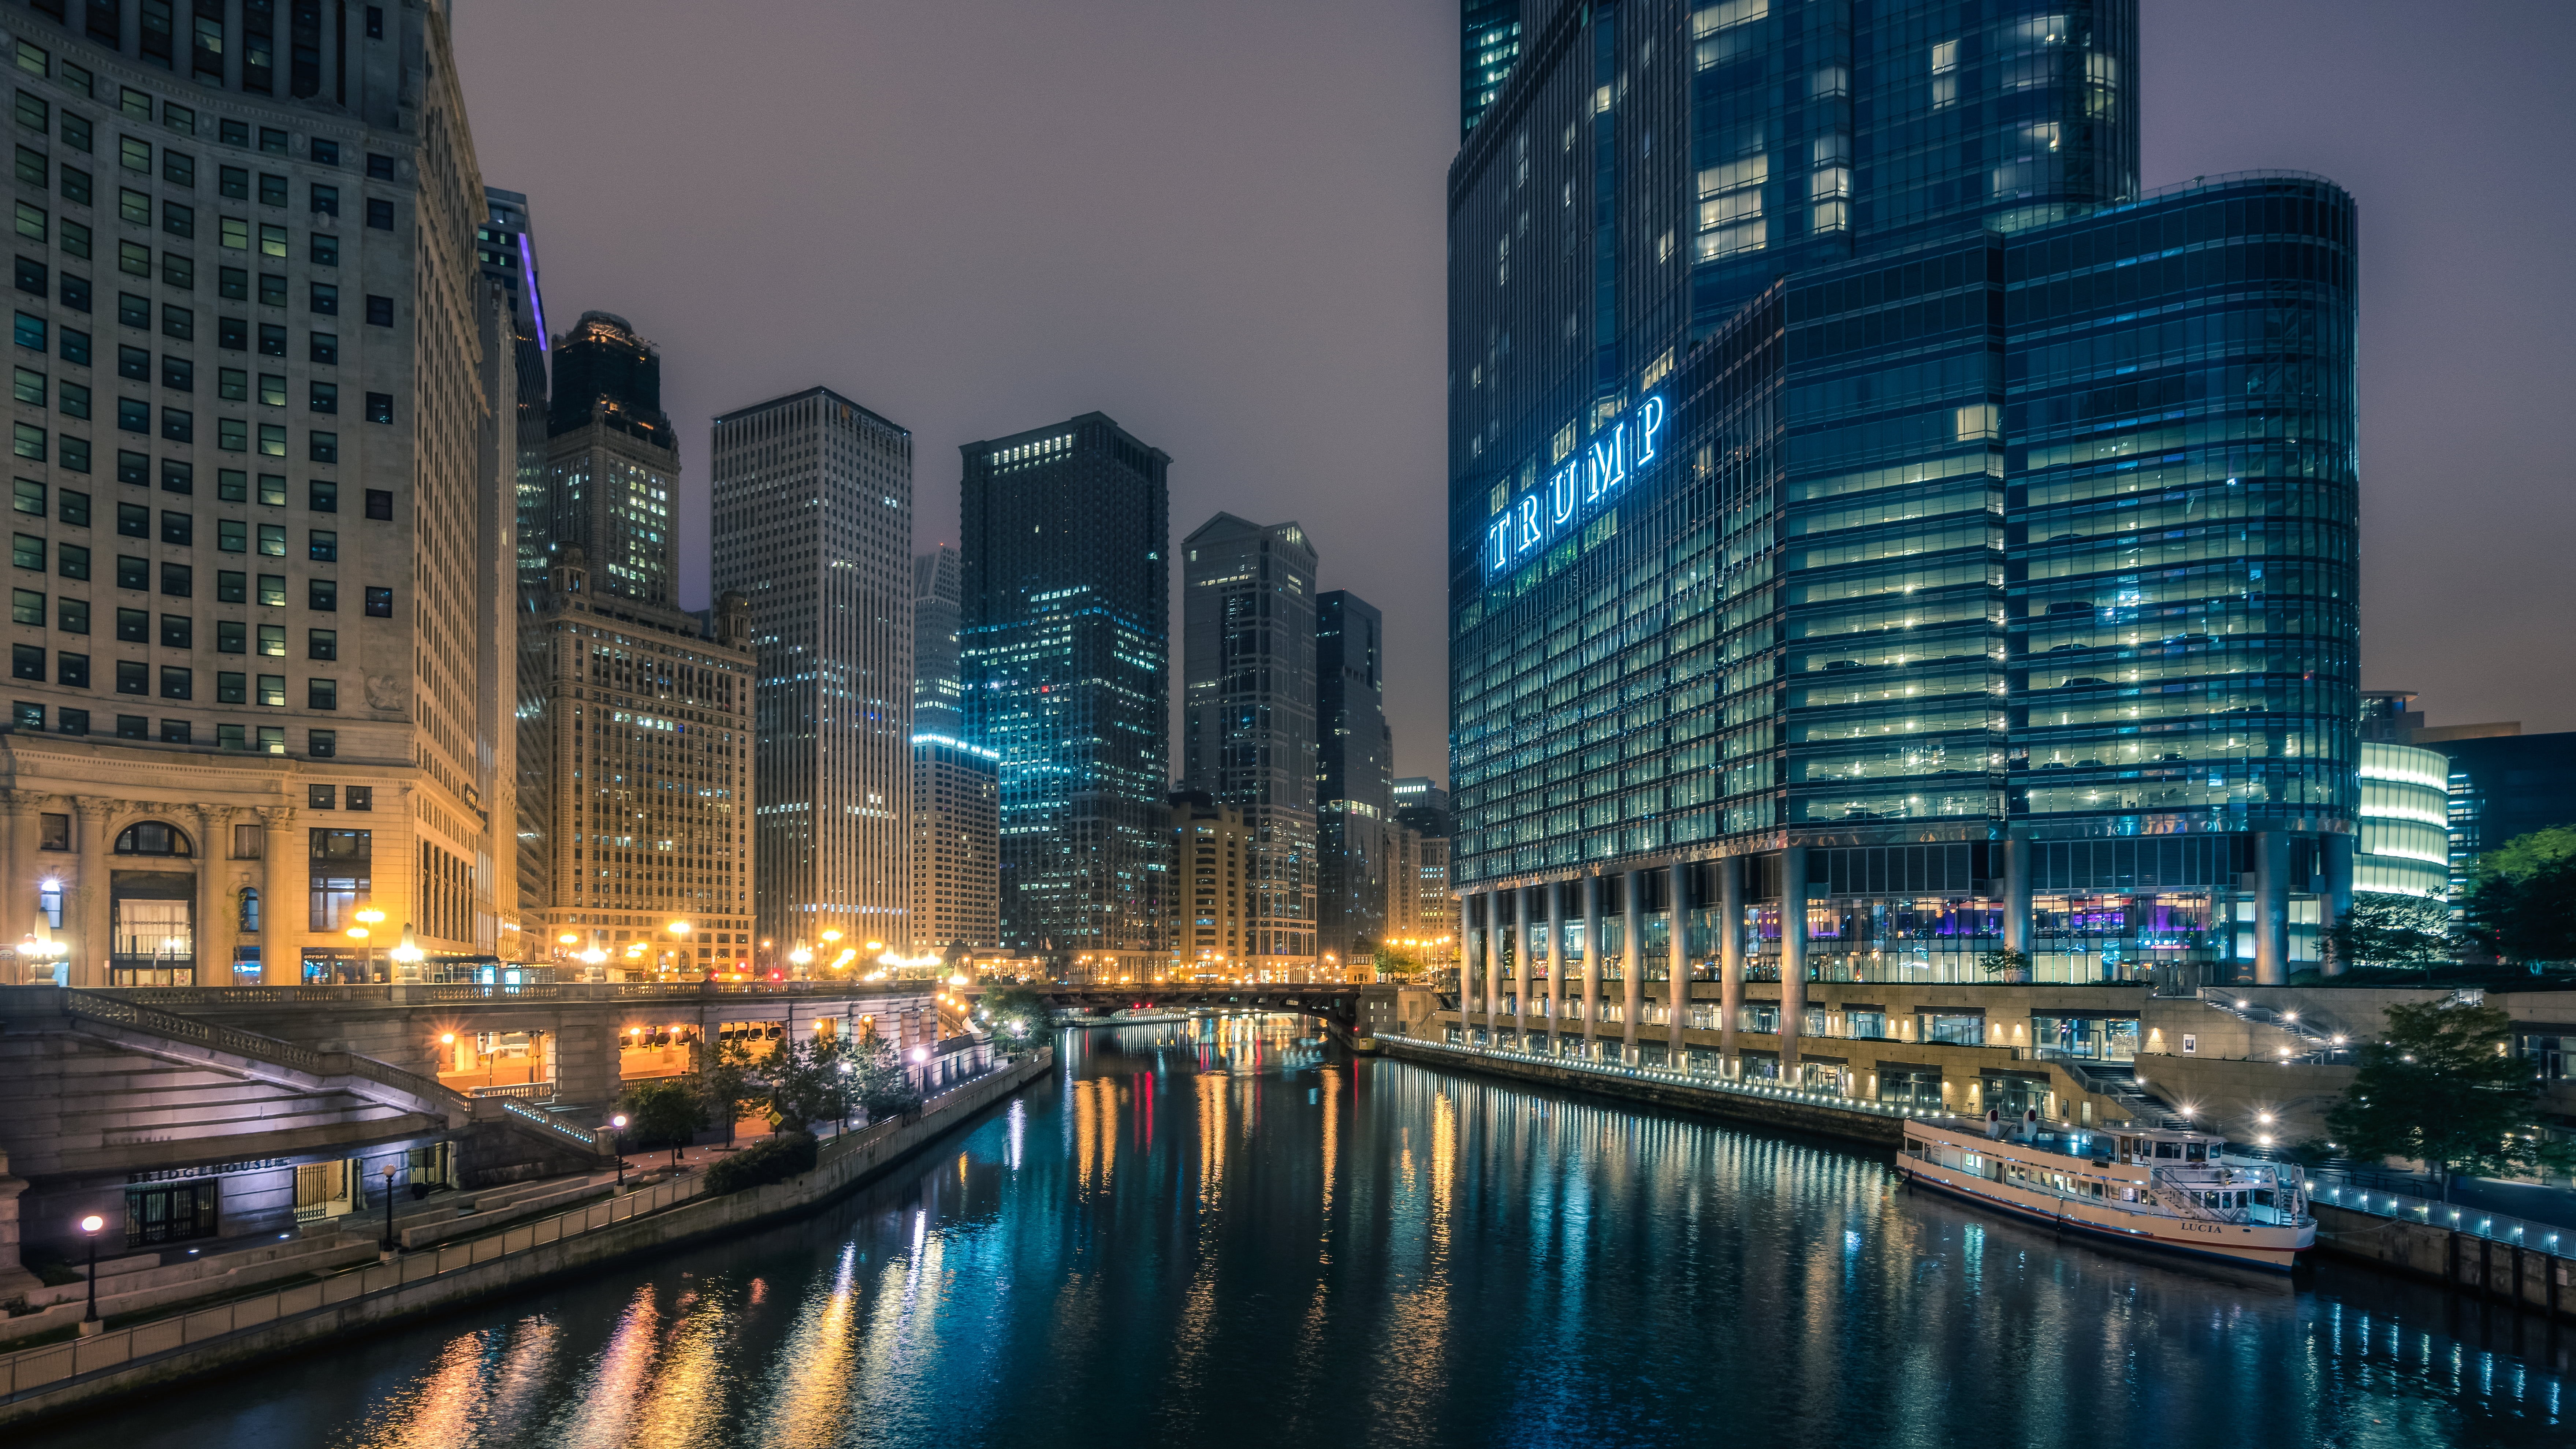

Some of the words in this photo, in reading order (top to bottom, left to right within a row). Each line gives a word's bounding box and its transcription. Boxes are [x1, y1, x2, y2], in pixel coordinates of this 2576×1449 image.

[853, 410, 900, 441] KEMPER
[1490, 395, 1663, 569] TRUMP
[128, 1159, 273, 1185] BRIDGEHOUSE
[2181, 1223, 2222, 1233] LUCIA
